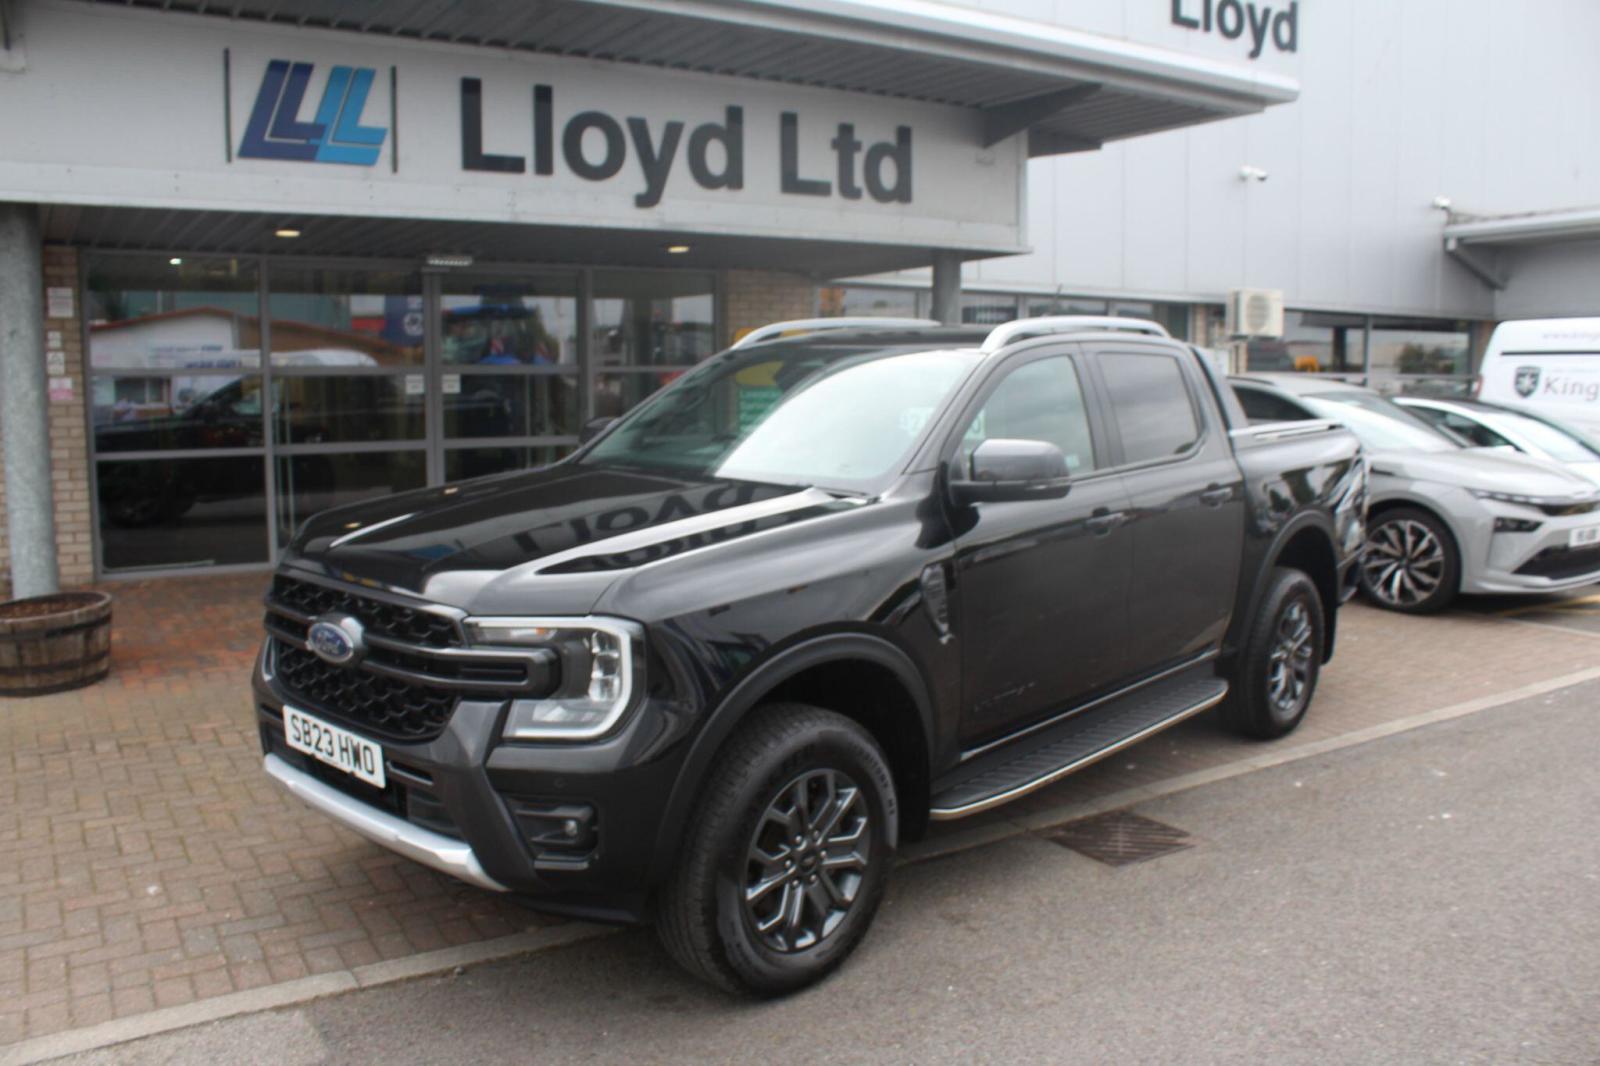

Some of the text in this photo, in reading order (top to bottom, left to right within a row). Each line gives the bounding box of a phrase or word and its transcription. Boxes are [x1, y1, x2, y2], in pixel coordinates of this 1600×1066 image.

[460, 76, 913, 208] Lloyd Ltd
[290, 713, 376, 776] SB23 HWO
